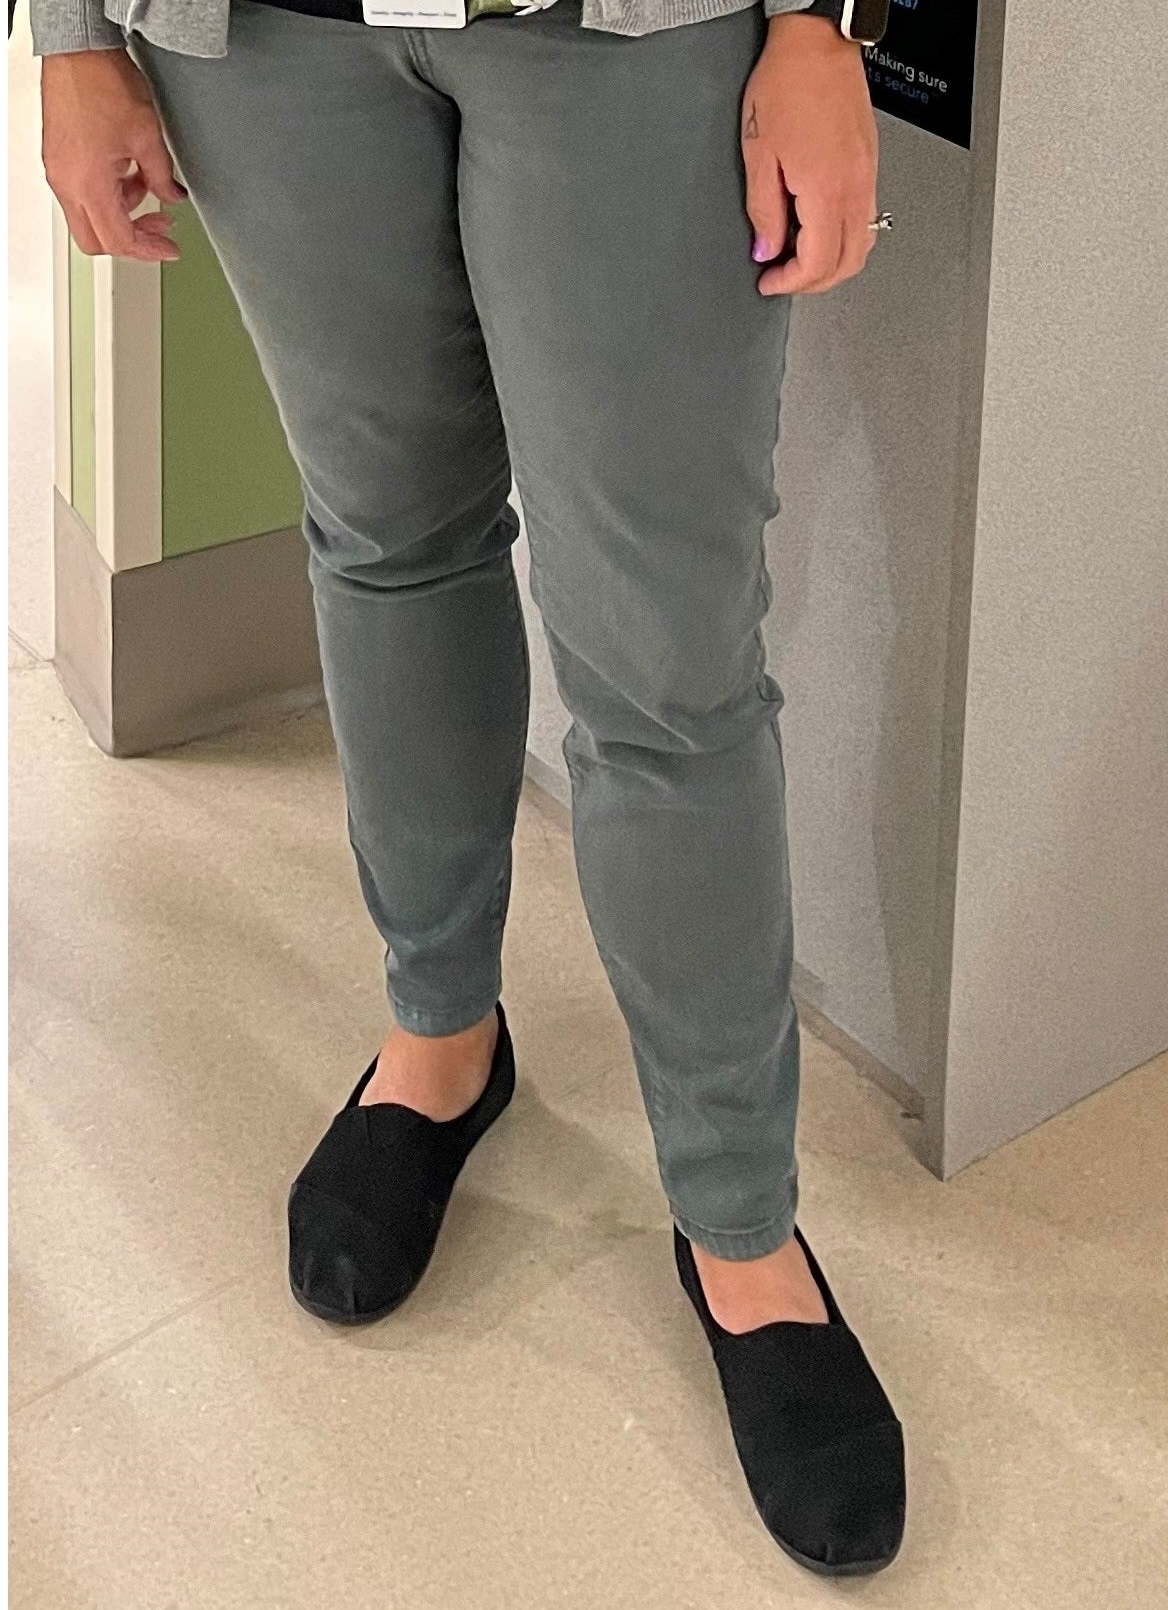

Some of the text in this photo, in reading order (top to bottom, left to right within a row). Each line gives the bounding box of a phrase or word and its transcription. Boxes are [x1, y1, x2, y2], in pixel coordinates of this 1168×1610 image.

[864, 46, 948, 93] Making sure
[884, 75, 929, 104] secure
